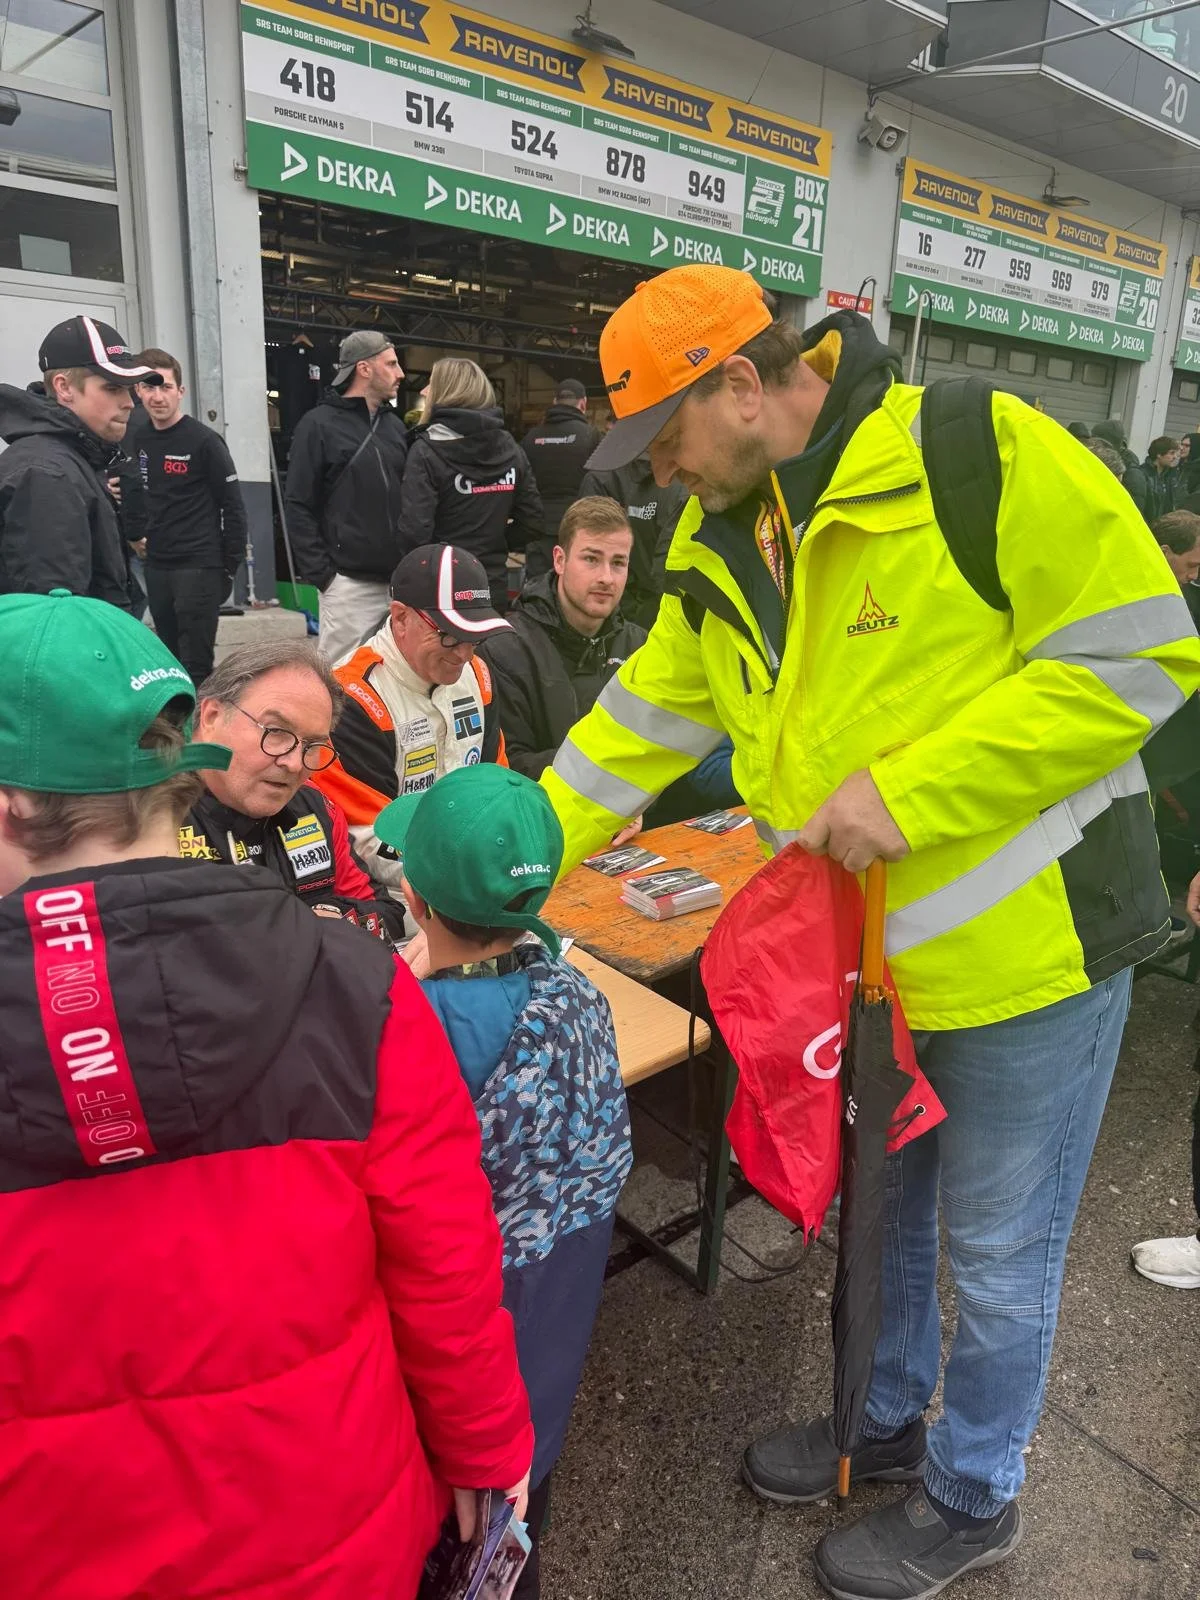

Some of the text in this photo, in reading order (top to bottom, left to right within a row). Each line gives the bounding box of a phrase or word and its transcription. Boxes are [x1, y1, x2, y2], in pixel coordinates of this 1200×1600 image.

[327, 0, 415, 30] ENOL
[256, 18, 355, 54] SRS TEAM SORG RENNSPORT
[465, 29, 574, 80] RAVENOL
[280, 57, 336, 102] 418
[385, 55, 398, 67] SRS
[399, 59, 417, 72] TEAM
[435, 70, 471, 88] RENNSPORT
[406, 90, 454, 133] 514
[509, 92, 525, 104] TEAM
[614, 78, 703, 121] RAVENOL
[1160, 76, 1188, 124] 20
[274, 106, 344, 130] PORSCHE CAYMAN S
[414, 140, 431, 151] BMW
[511, 119, 558, 160] 524
[736, 119, 812, 156] RAVENOL
[317, 155, 397, 198] DEKRA
[514, 165, 554, 182] TOYOTA SUPRA
[606, 146, 646, 183] 878
[598, 186, 611, 195] BMW
[619, 192, 638, 202] RACING
[688, 170, 725, 203] 949
[794, 175, 825, 206] BOX
[920, 178, 976, 207] RAVENOL
[455, 187, 522, 223] DEKRA
[995, 203, 1044, 228] RAVENOL
[573, 213, 630, 247] DEKRA
[792, 203, 823, 251] 21
[1060, 224, 1104, 247] RAVENOL
[673, 236, 723, 265] DEKRA
[918, 231, 933, 256] 16
[964, 245, 986, 269] 277
[1118, 243, 1157, 264] RAVENOL
[761, 256, 805, 283] DEKRA
[1009, 258, 1031, 281] 959
[1051, 269, 1072, 292] 969
[1091, 280, 1109, 301] 979
[1144, 277, 1162, 297] BOX
[980, 303, 1009, 325] DEKRA
[1031, 315, 1059, 335] DEKRA
[1136, 295, 1158, 329] 20
[1079, 326, 1104, 344] DEKRA
[1122, 335, 1145, 352] DEKRA
[847, 615, 899, 634] DEUTZ
[347, 682, 384, 720] sparco
[35, 889, 94, 952] OFF
[61, 1027, 119, 1083] ON
[76, 1090, 137, 1146] OFF
